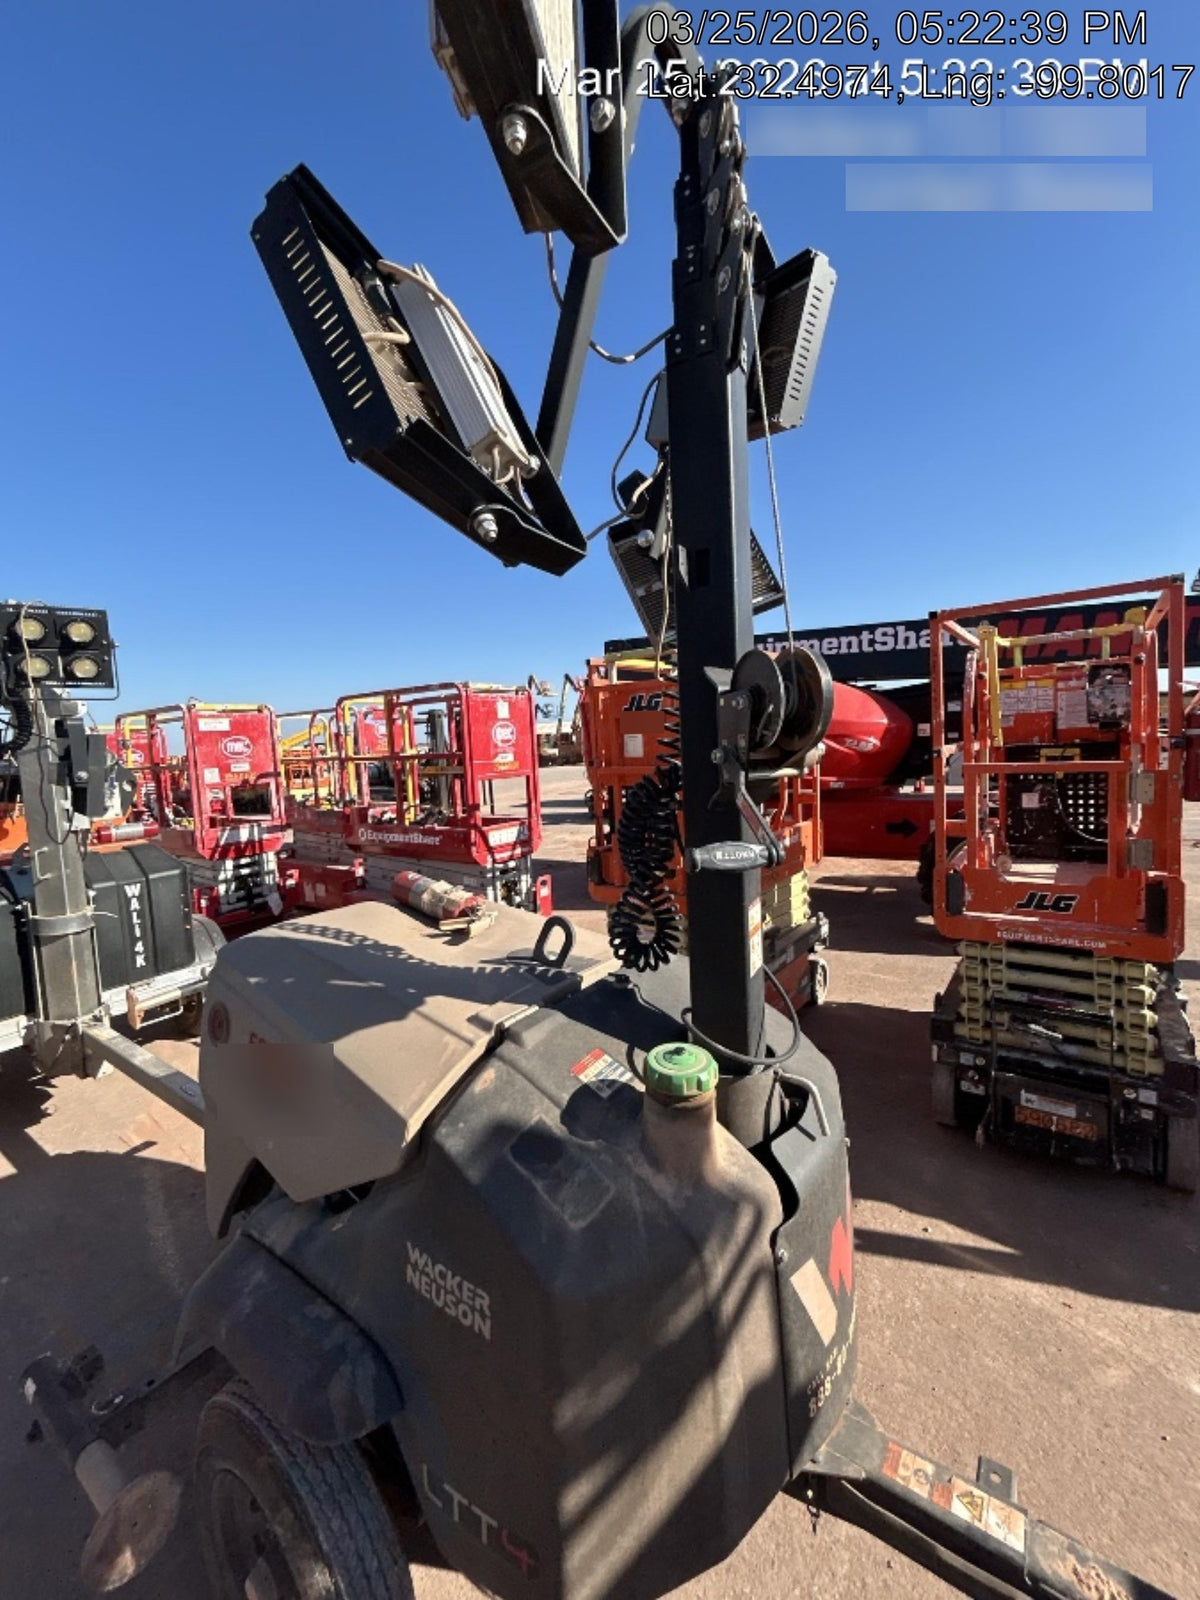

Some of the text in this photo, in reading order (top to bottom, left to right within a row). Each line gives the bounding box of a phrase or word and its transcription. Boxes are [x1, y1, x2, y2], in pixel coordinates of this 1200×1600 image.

[622, 691, 664, 711] JLG
[1016, 891, 1079, 914] JLG
[406, 1241, 491, 1317] WACKER
[406, 1263, 491, 1340] NEUSON
